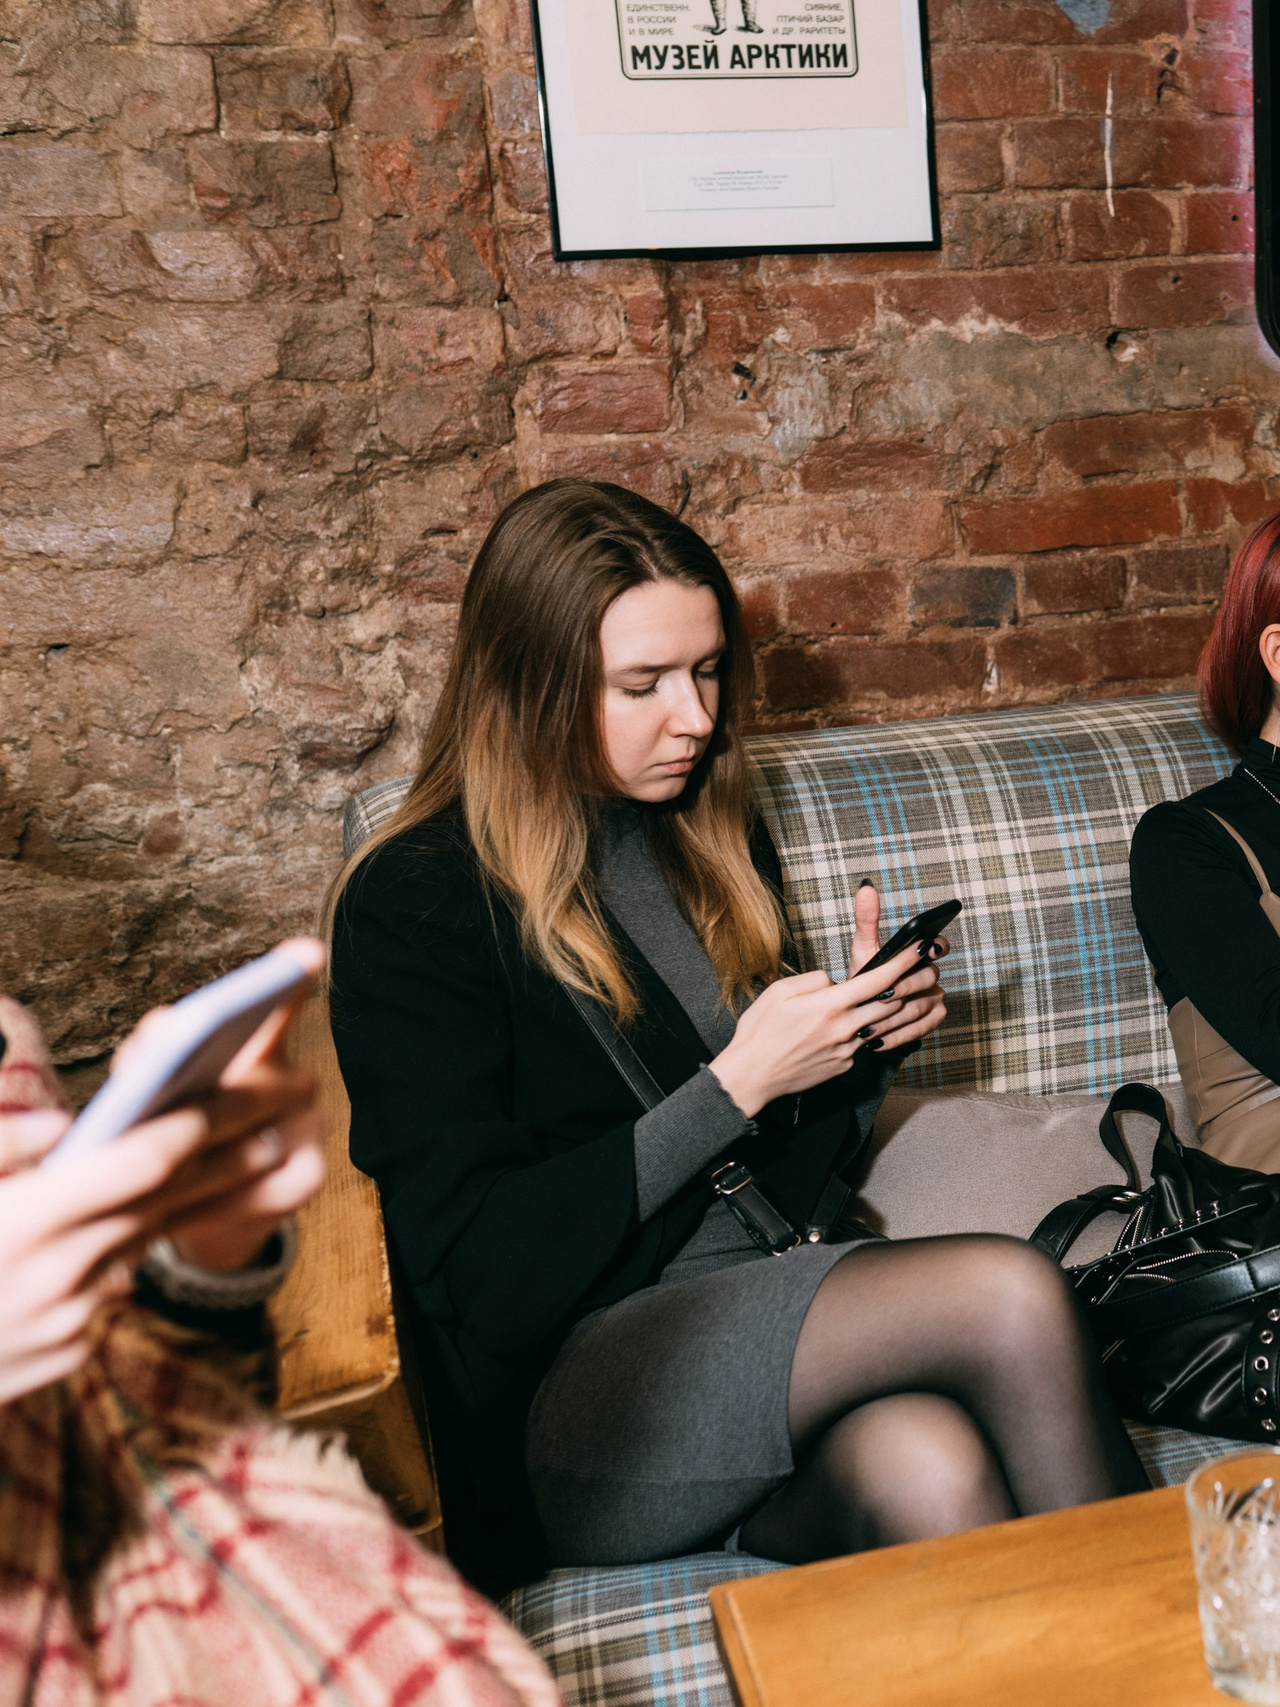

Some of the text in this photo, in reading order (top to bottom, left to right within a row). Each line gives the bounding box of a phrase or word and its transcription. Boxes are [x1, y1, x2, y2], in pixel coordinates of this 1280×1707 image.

[626, 3, 690, 12] ЕДИНСТВЕНН.
[627, 15, 676, 24] В РОССИИ
[776, 14, 845, 23] ПТИЧИЙ БАЗАР
[628, 28, 635, 36] И
[799, 26, 846, 34] РАРИТЕТЫ
[631, 40, 848, 69] МУЗЕЙ АРКТИКИ
